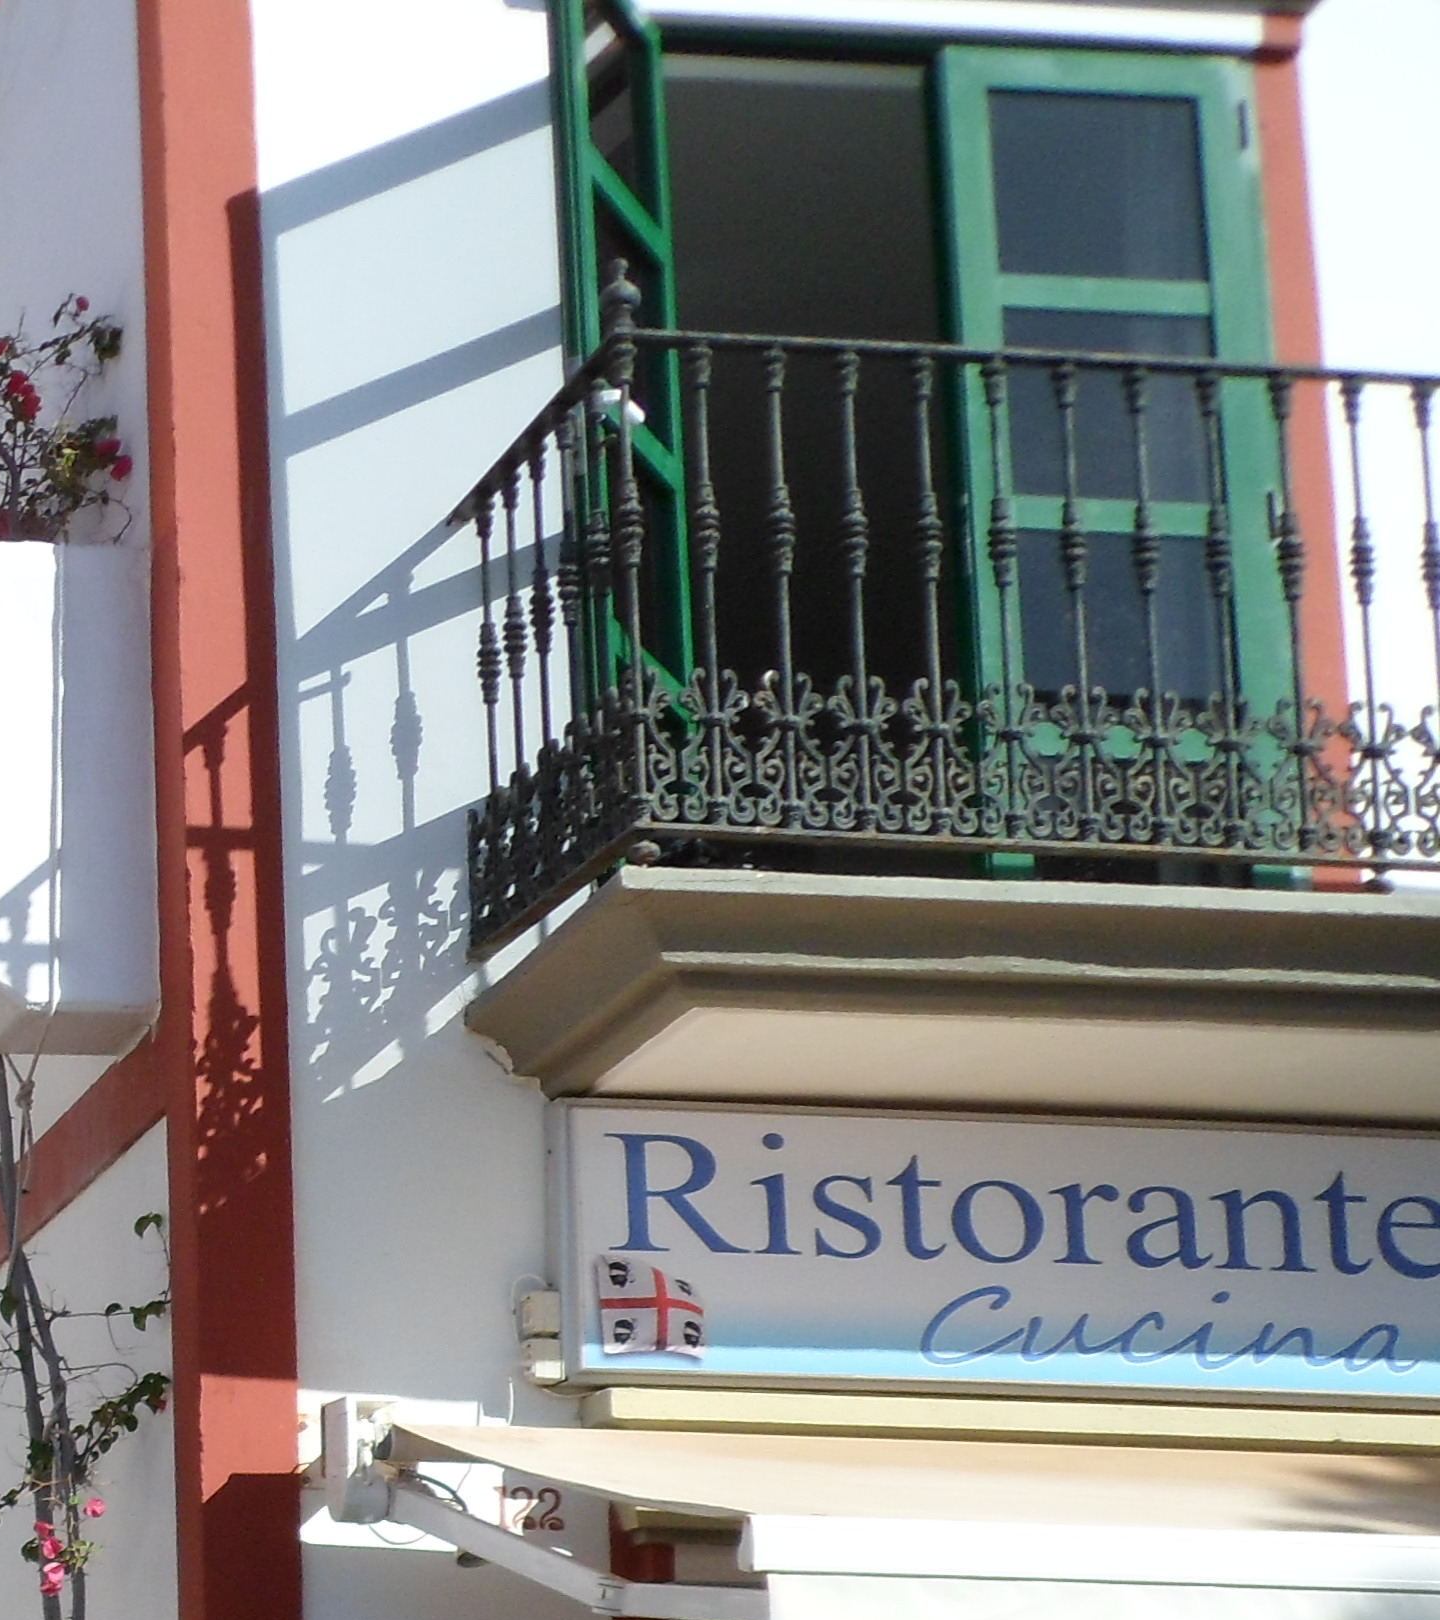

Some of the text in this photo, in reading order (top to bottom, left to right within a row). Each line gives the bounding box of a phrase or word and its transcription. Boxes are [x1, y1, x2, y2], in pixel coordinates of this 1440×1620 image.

[604, 1131, 1440, 1279] Ristorante
[919, 1285, 1421, 1374] Cucina
[493, 1486, 564, 1530] 122
